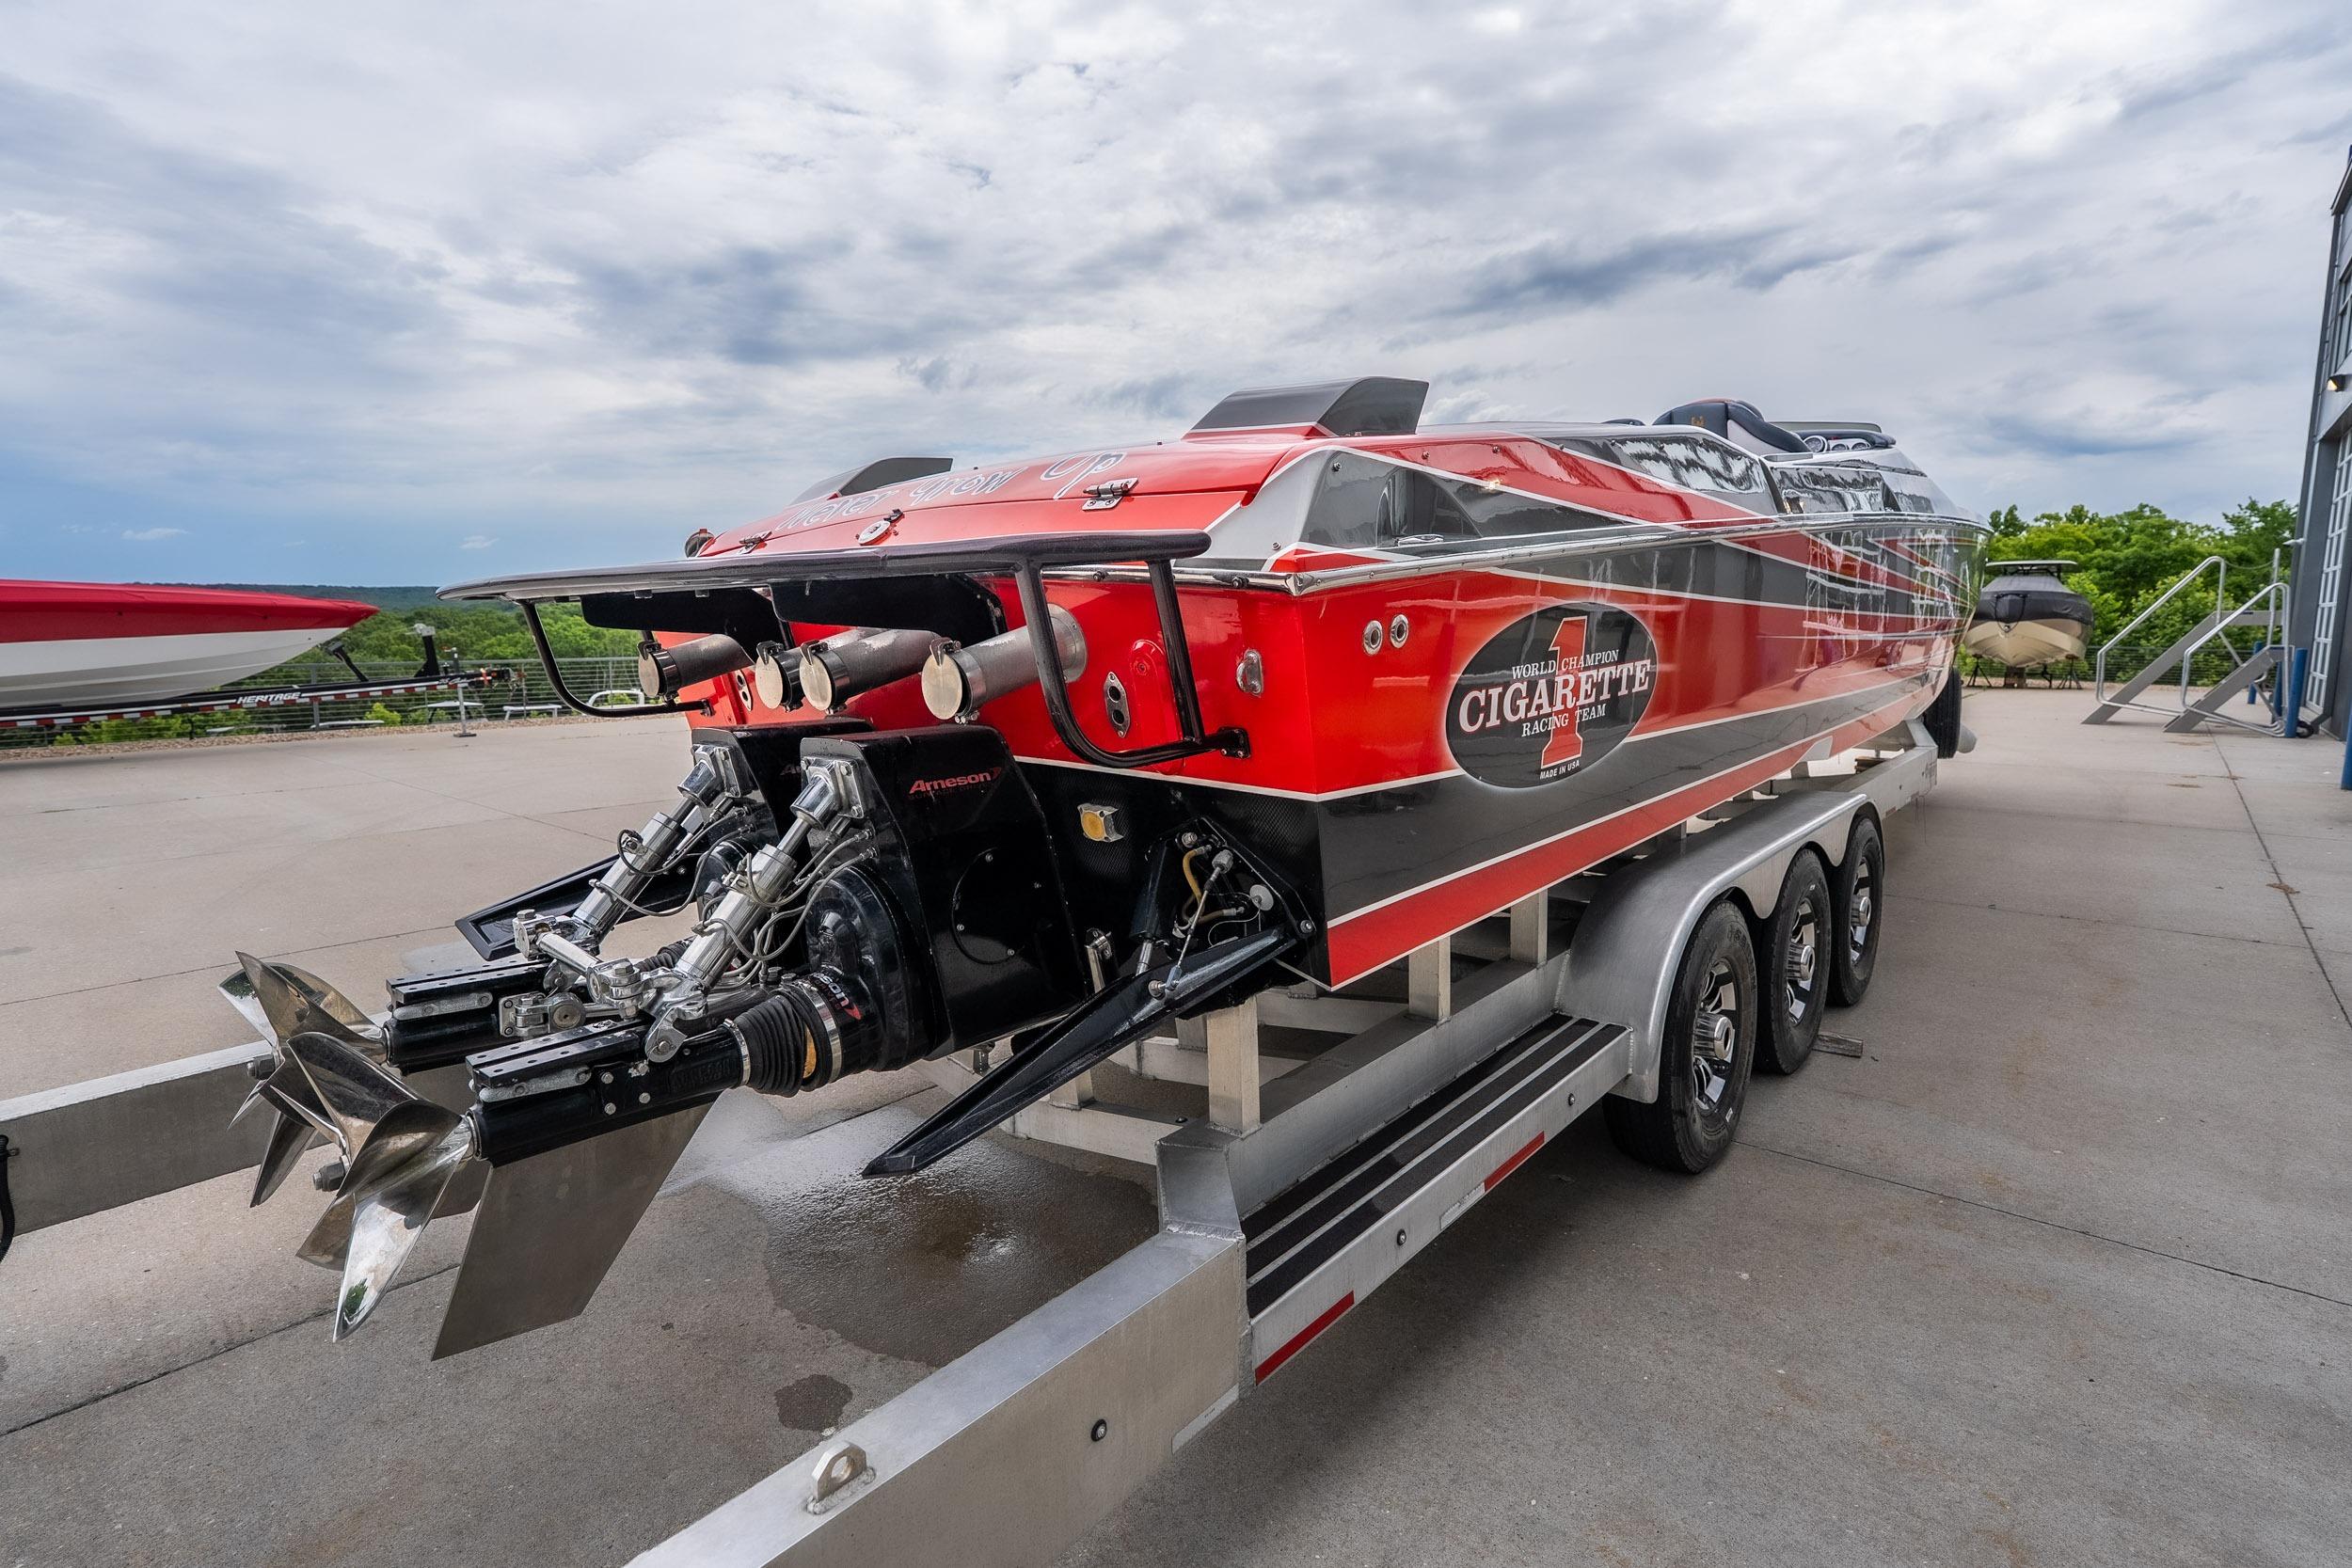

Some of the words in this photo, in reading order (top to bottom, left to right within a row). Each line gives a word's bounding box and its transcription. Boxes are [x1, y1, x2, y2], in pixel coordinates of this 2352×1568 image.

[1511, 659, 1557, 680] WORLD
[1561, 649, 1620, 673] CHAMPION
[236, 691, 302, 705] HERITAGE
[1458, 658, 1651, 733] CIGARETTE
[1521, 712, 1569, 737] RACING
[1574, 703, 1607, 723] TEAM
[909, 771, 993, 795] Arneson
[1539, 768, 1558, 781] MADE
[1558, 765, 1566, 776] IN
[1566, 759, 1581, 771] USA
